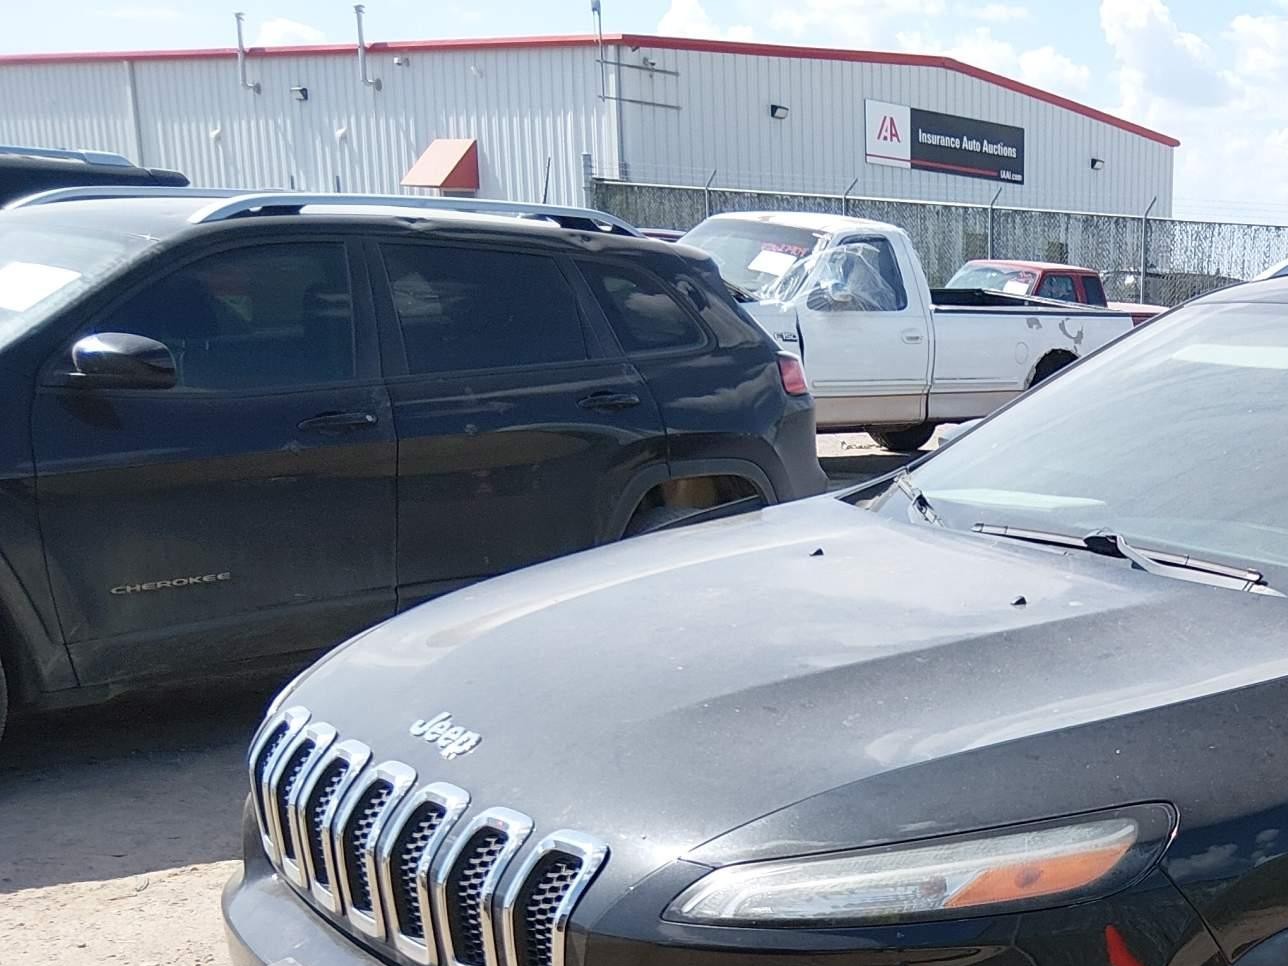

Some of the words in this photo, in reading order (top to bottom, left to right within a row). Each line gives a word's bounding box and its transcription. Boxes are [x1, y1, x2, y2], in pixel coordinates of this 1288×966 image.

[918, 128, 960, 148] Insurance
[962, 135, 981, 152] Auto
[982, 139, 1017, 158] Auctions
[110, 571, 231, 595] CHEROKEE
[409, 711, 482, 761] Jeep
